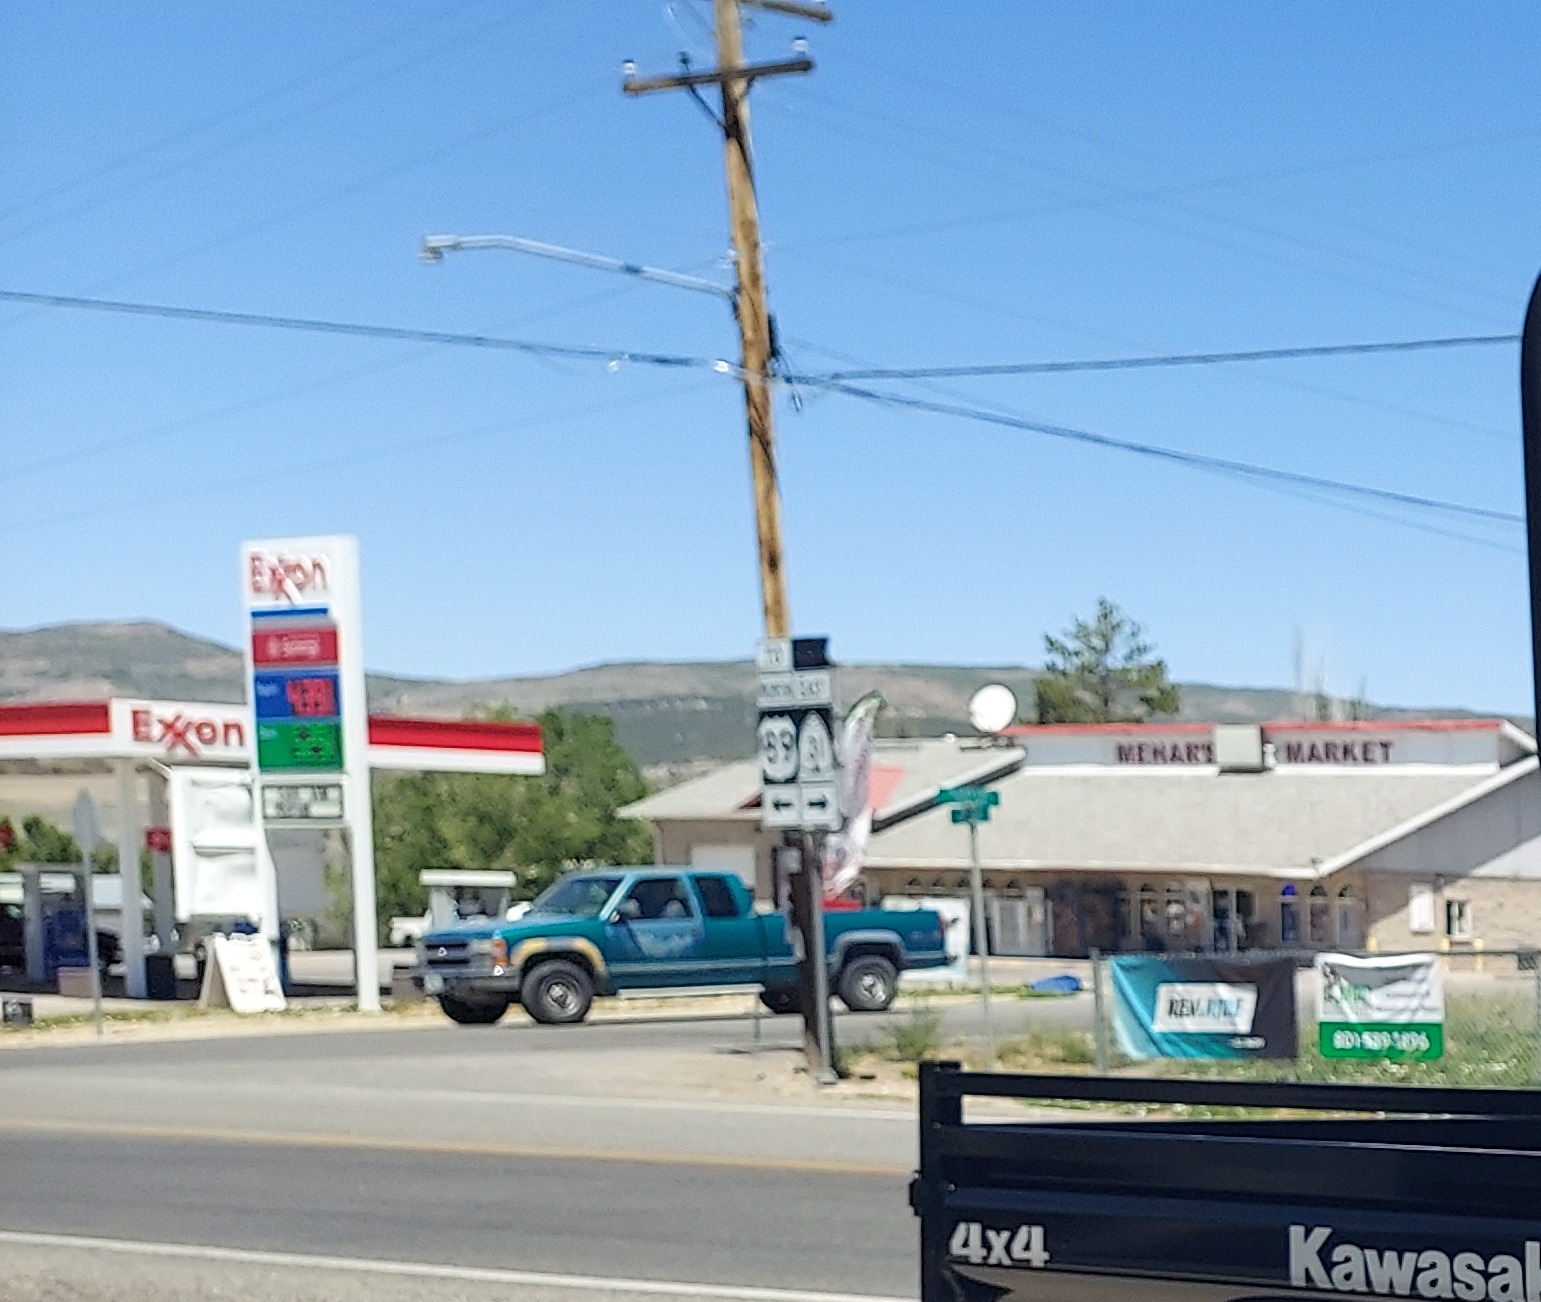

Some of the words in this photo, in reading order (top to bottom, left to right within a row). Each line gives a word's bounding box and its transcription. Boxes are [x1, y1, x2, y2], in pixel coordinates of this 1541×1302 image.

[131, 709, 244, 756] Exxon
[1286, 741, 1395, 763] MARKET
[948, 1221, 1051, 1269] 4x4
